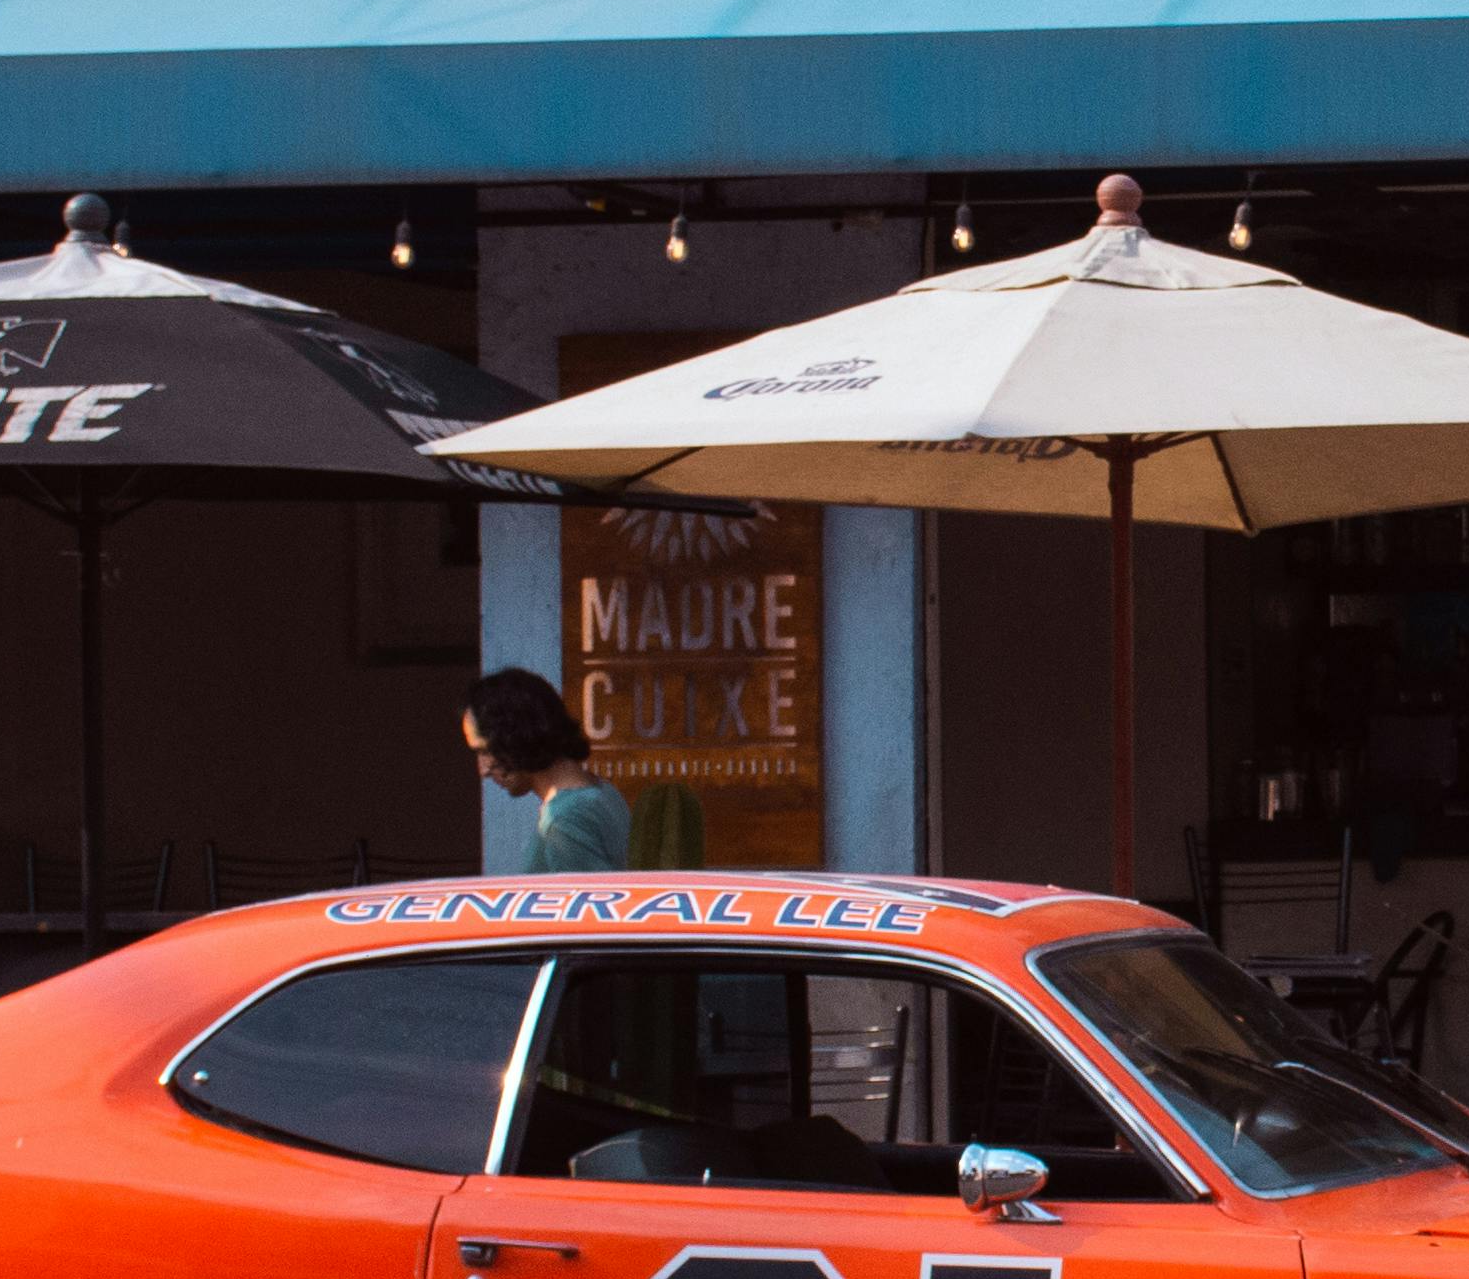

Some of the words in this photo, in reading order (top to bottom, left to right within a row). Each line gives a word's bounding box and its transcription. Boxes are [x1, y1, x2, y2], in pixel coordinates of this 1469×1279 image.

[703, 375, 882, 401] Corona
[582, 575, 797, 652] MADRE
[583, 670, 797, 740] CUIXE
[326, 888, 752, 926] GENERAL
[774, 893, 937, 934] LEE
